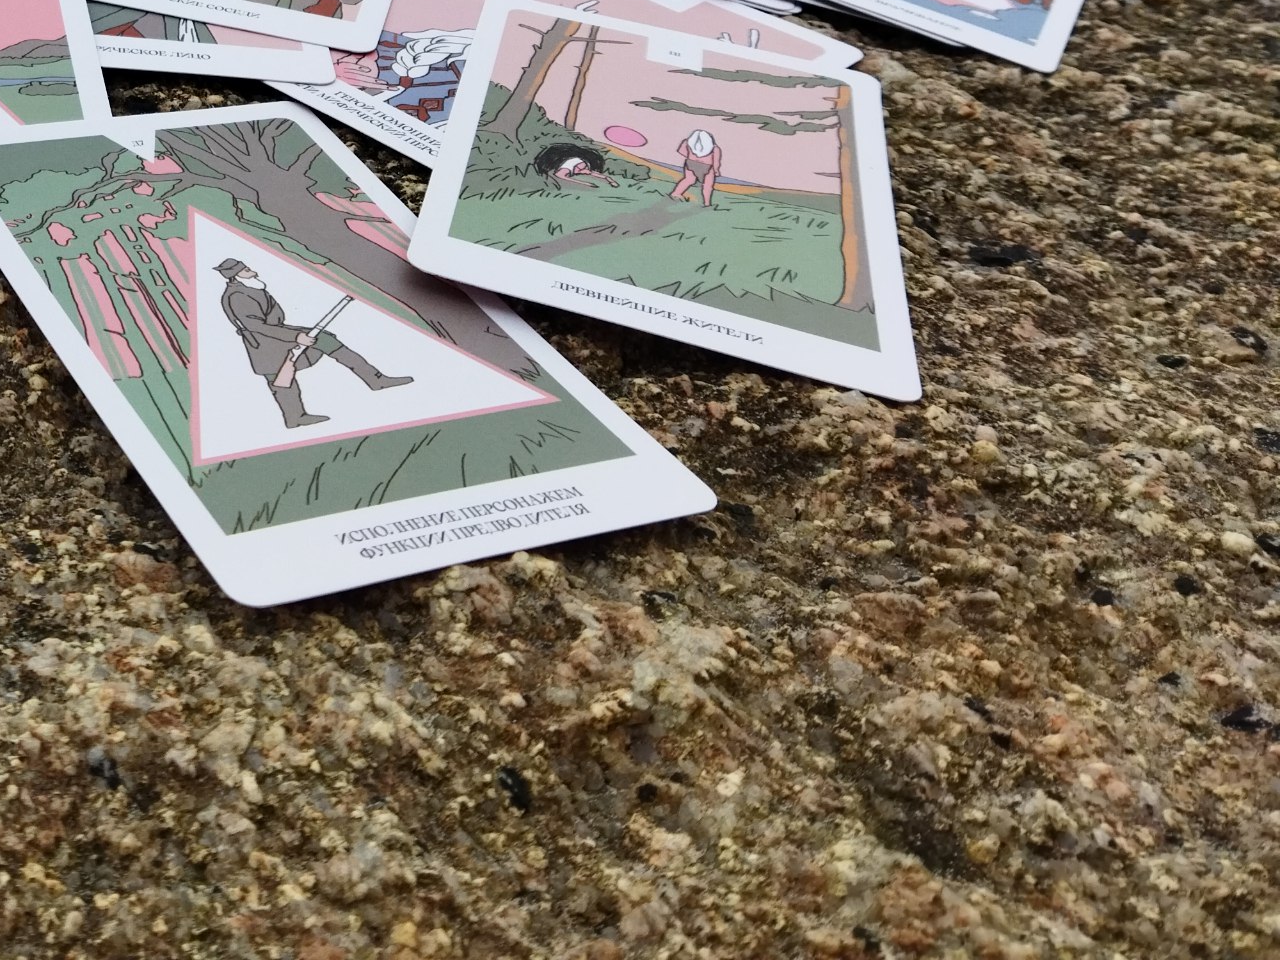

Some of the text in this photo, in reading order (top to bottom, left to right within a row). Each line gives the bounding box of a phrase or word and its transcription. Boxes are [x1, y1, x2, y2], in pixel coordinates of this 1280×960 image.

[206, 4, 261, 18] СОСЕДИ
[317, 94, 406, 139] МИФИЧЕСКИЙ
[334, 91, 375, 113] ГЕРОЙ
[551, 280, 764, 345] ДРЕВНЕЙШИЕ ЖИТЕЛИ
[334, 486, 585, 545] ИСПОЛНЕНИЕ ПЕРСОНАЖЕМ
[359, 503, 591, 559] ФУНКЦИИ ПРЕДВОДИТЕЛЯ
